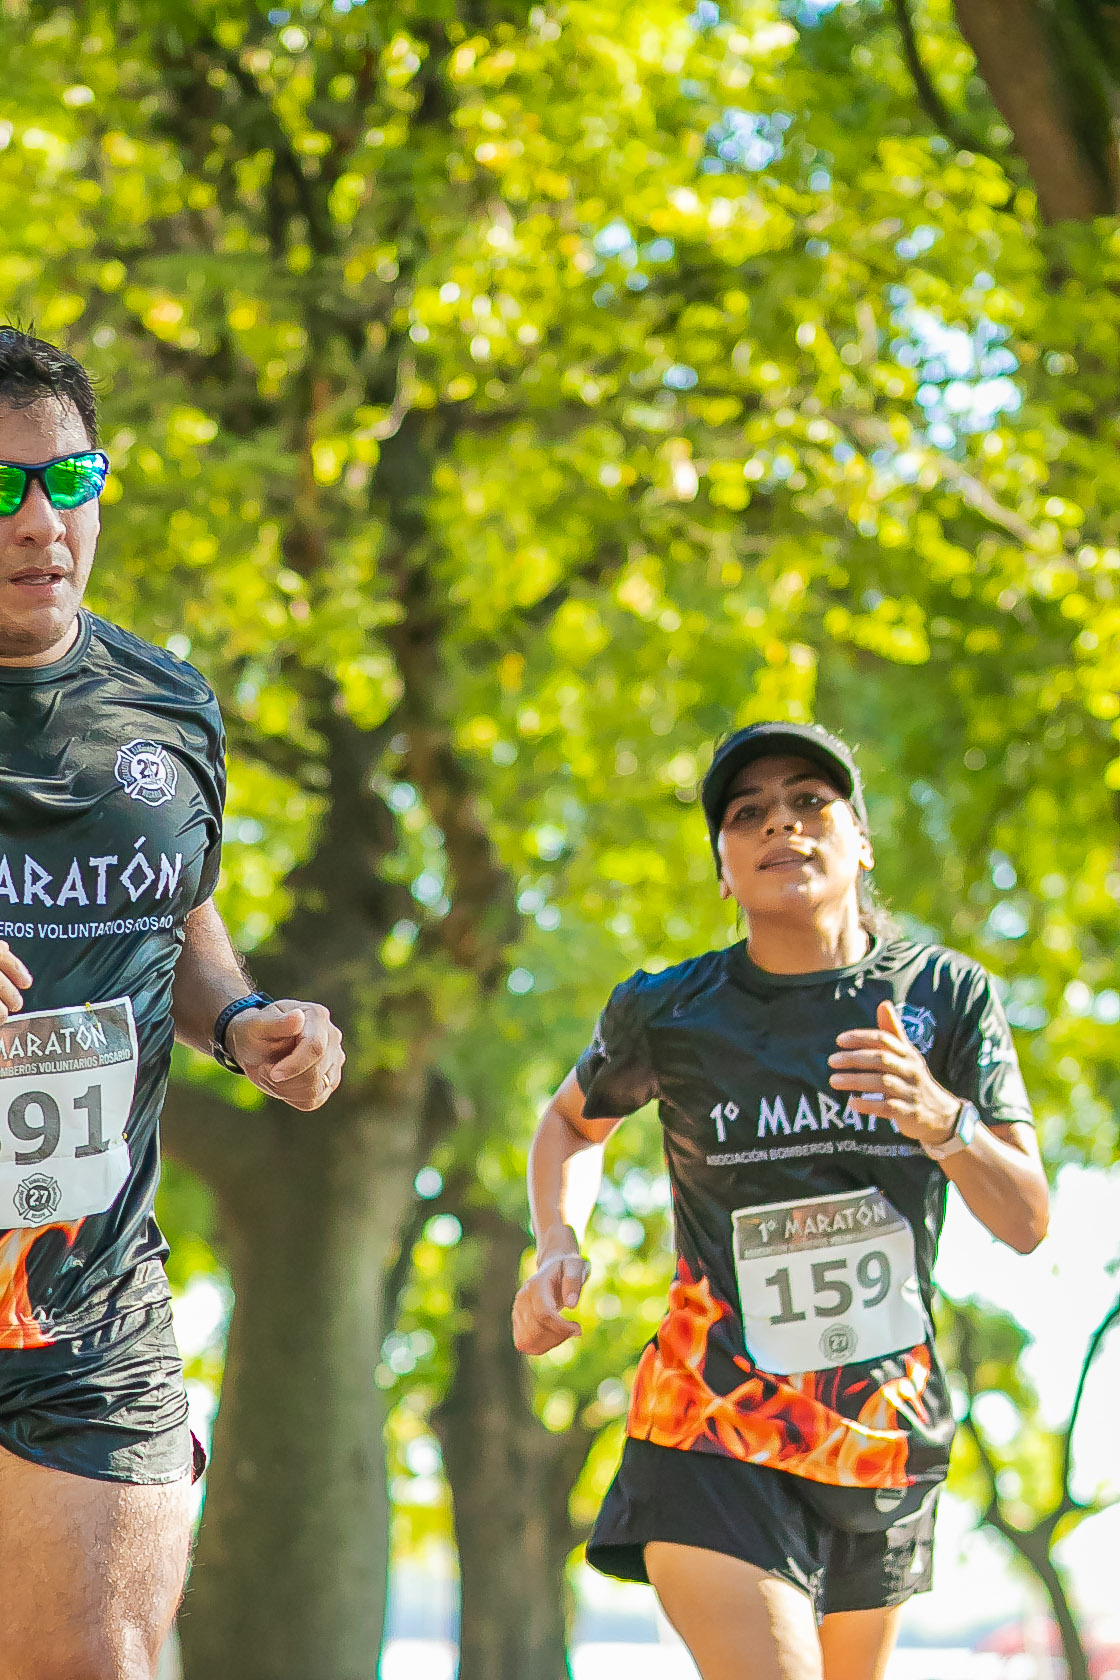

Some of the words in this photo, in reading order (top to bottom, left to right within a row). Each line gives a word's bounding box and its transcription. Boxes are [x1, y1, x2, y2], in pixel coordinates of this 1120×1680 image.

[136, 758, 160, 780] 27
[38, 918, 134, 939] VOLUNTARIOS
[39, 1054, 98, 1075] VOLUNTARIOS
[99, 1048, 131, 1066] ROSARIO
[757, 1091, 900, 1138] MARAT
[29, 1188, 49, 1207] 27
[784, 1200, 887, 1240] MARATÓN
[765, 1251, 892, 1326] 159
